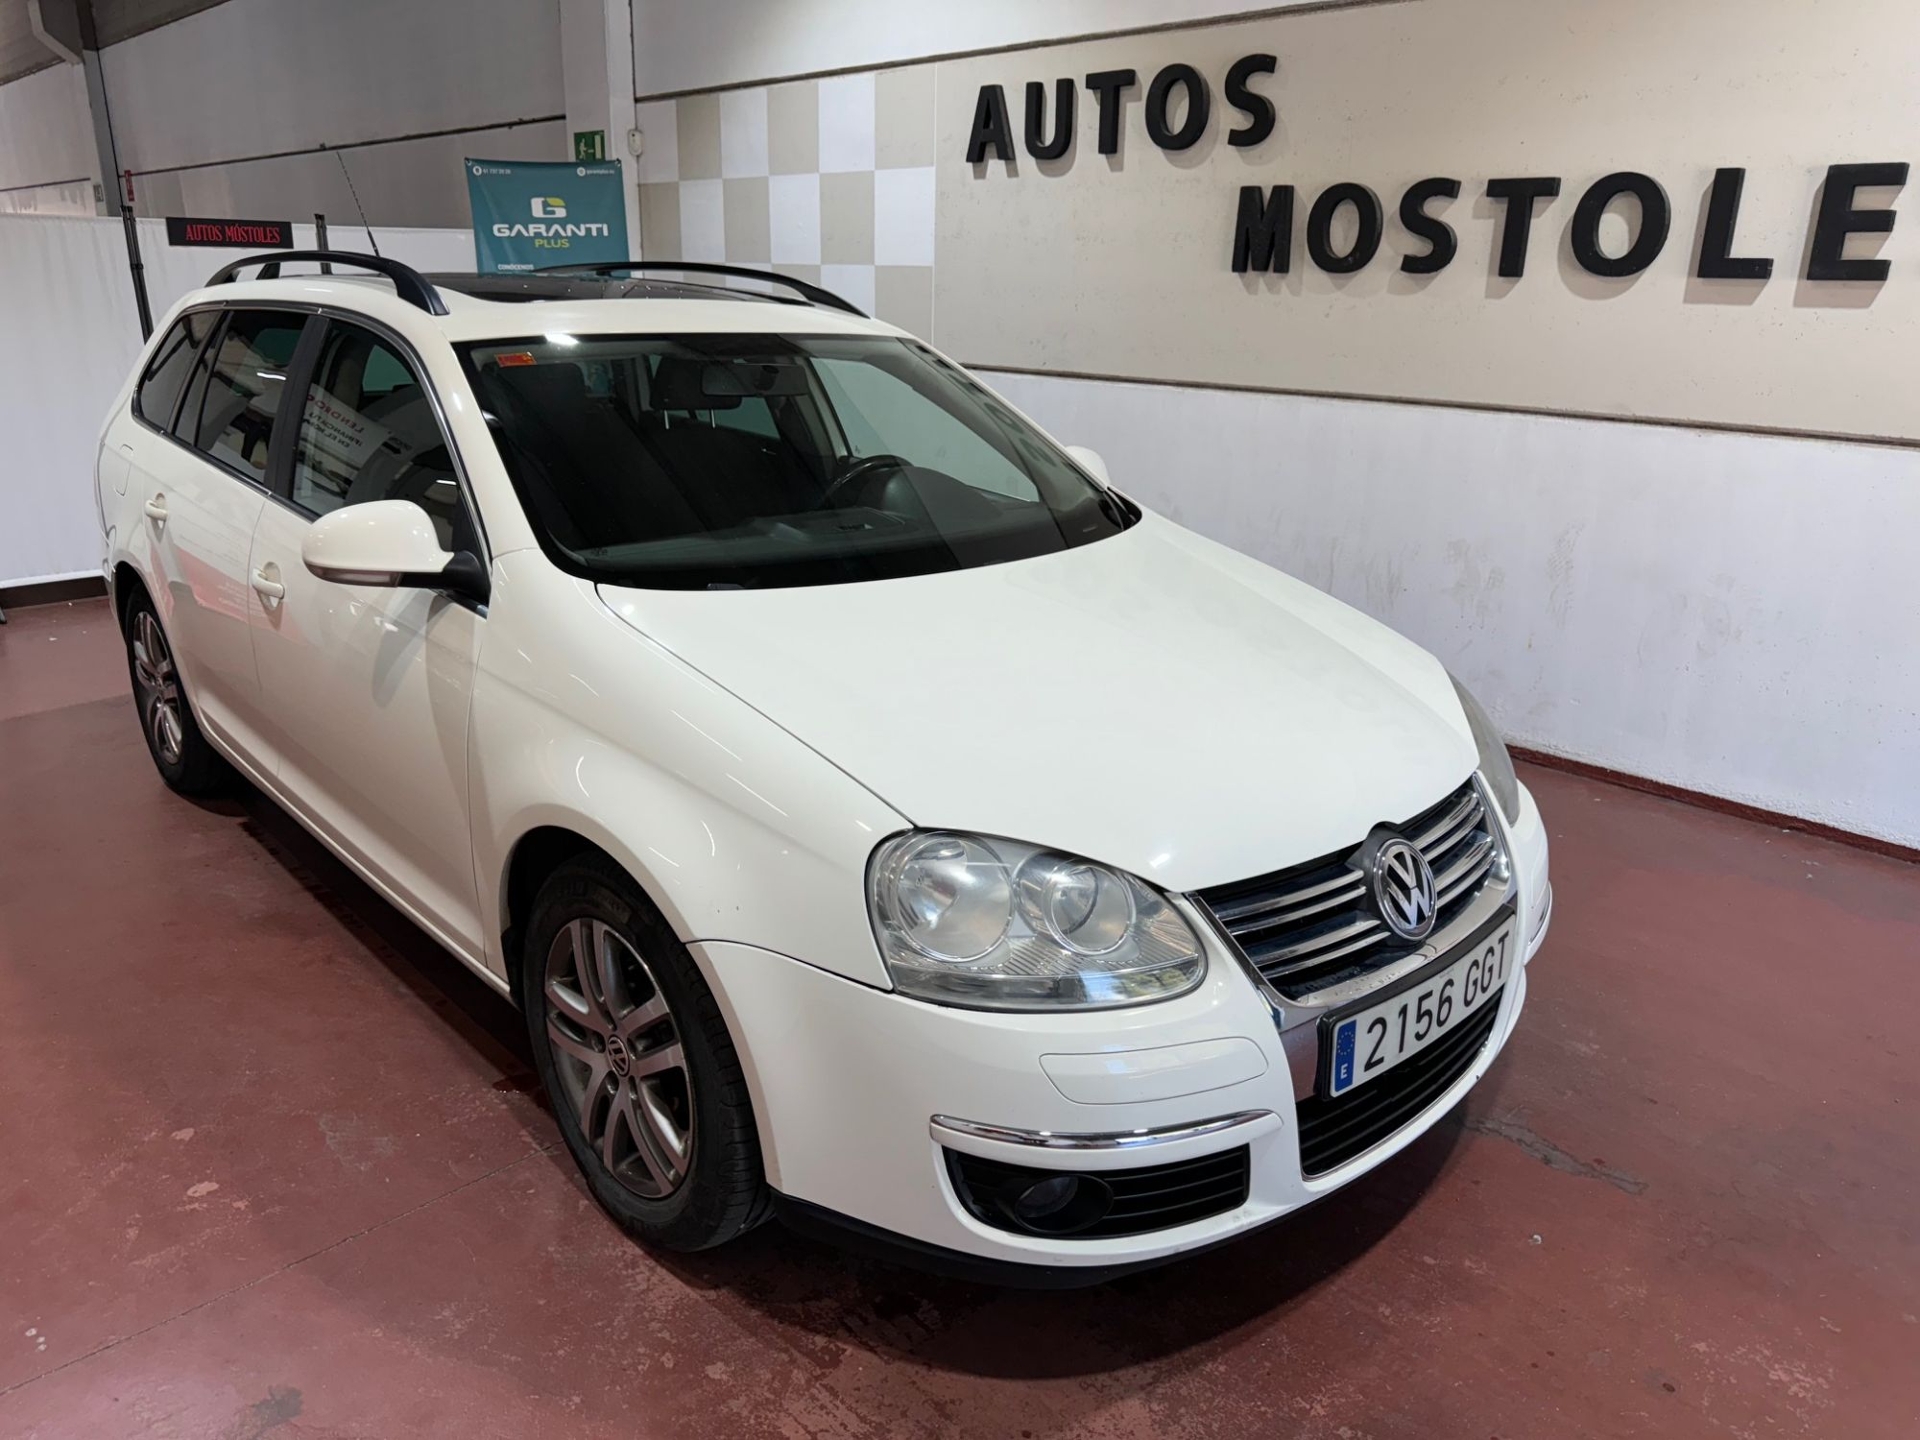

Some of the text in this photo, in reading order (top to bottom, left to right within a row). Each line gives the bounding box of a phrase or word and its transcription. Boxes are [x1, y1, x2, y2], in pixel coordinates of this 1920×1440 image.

[966, 53, 1277, 163] AUTOS
[492, 223, 609, 237] GARANTI
[1232, 161, 1910, 281] MOSTOLE
[186, 223, 281, 244] AUTOS MÓSTOLES
[534, 238, 570, 249] PLUS
[1363, 929, 1510, 1073] 2156 GGT
[1340, 1062, 1349, 1080] E
